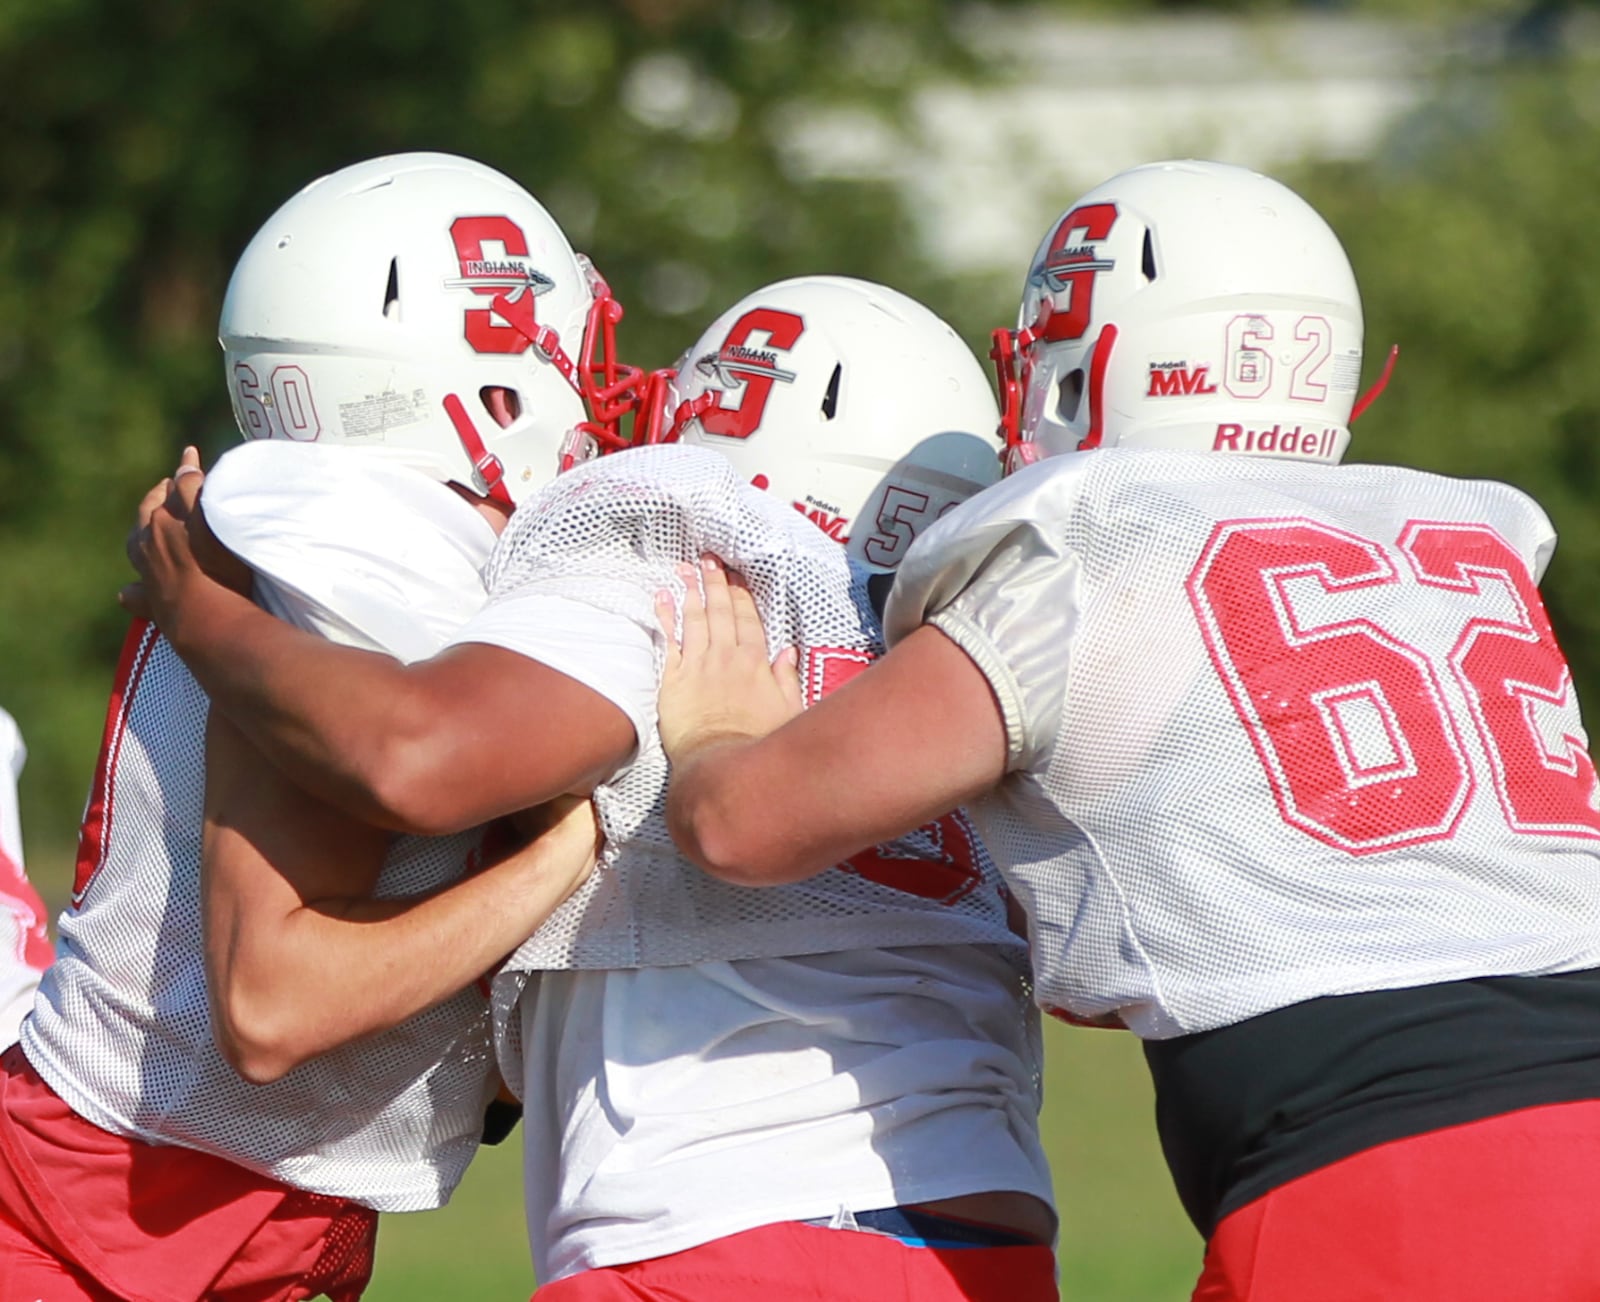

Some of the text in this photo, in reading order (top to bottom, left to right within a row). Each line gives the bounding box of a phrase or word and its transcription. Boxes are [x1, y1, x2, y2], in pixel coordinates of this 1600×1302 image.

[449, 215, 535, 354] S
[467, 261, 526, 275] INDIANS
[1040, 203, 1119, 344] S
[698, 308, 806, 440] S
[1146, 367, 1218, 397] MVL
[1223, 315, 1332, 402] 62
[234, 363, 321, 442] 60
[1211, 423, 1337, 458] Riddell
[864, 485, 962, 568] 5
[1184, 516, 1600, 857] 62
